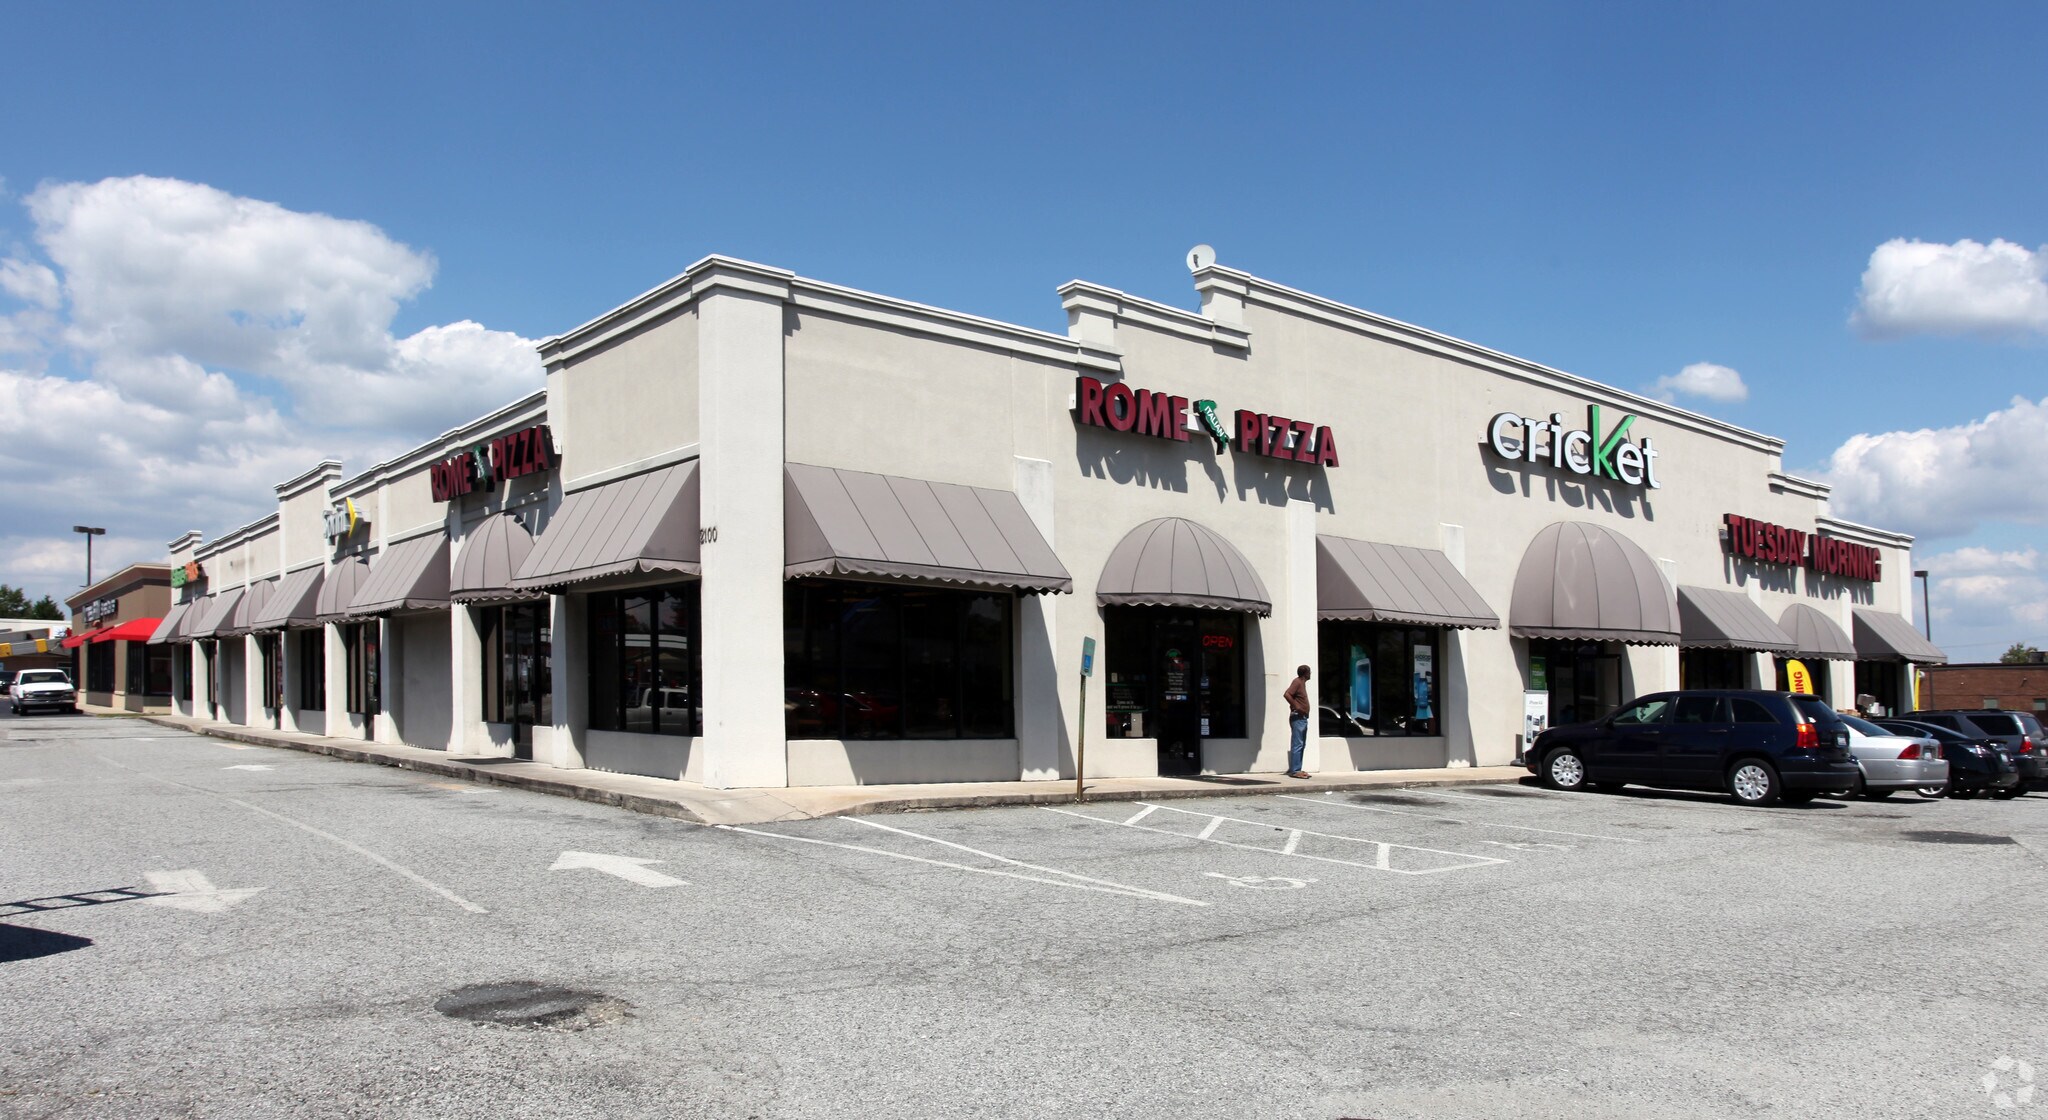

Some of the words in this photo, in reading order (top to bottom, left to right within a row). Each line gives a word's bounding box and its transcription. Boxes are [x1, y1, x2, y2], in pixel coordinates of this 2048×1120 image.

[1076, 376, 1191, 442] ROME
[1234, 409, 1339, 468] PIZZA
[1204, 405, 1225, 437] ITALIAN
[431, 452, 473, 503] ROME
[492, 425, 551, 482] PIZZA
[1724, 513, 1807, 567] TUESDAY
[1809, 534, 1882, 582] MORNING
[1202, 635, 1233, 649] OPEN
